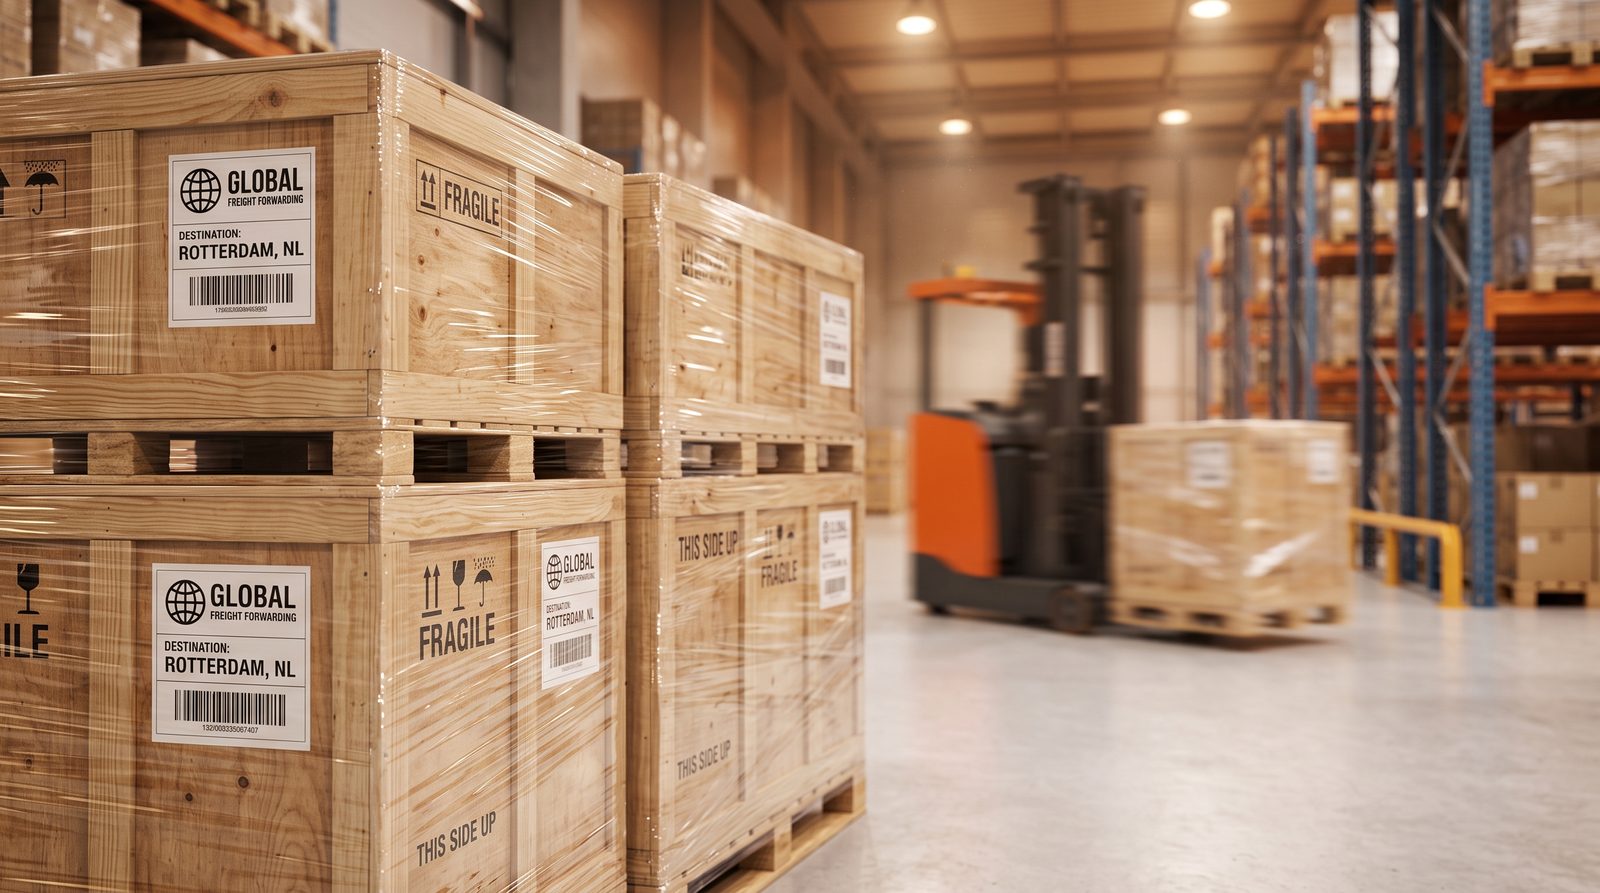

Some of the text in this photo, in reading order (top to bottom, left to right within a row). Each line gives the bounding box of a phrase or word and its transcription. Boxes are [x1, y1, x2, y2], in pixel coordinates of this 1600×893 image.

[228, 167, 303, 194] GLOBAL
[228, 194, 304, 207] FREIGHT FORWARDING
[444, 180, 500, 227] FRAGILE
[179, 229, 241, 241] DESTINATION:
[179, 241, 304, 260] ROTTERDAM, NL
[678, 530, 738, 562] THIS SIDE UP
[563, 553, 595, 573] GLOBAL
[761, 560, 798, 588] FRAGILE
[210, 583, 296, 609] GLOBAL
[210, 611, 297, 622] FREIGHT FORWARDING
[546, 608, 595, 631] ROTTERDAM, NL
[0, 623, 49, 659] ILE
[164, 641, 230, 653] DESTINATION:
[419, 612, 495, 661] FRAGILE
[165, 656, 296, 680] ROTTERDAM, NL
[677, 739, 731, 781] THIS SIDE UP
[416, 811, 497, 867] THIS SIDE UP
